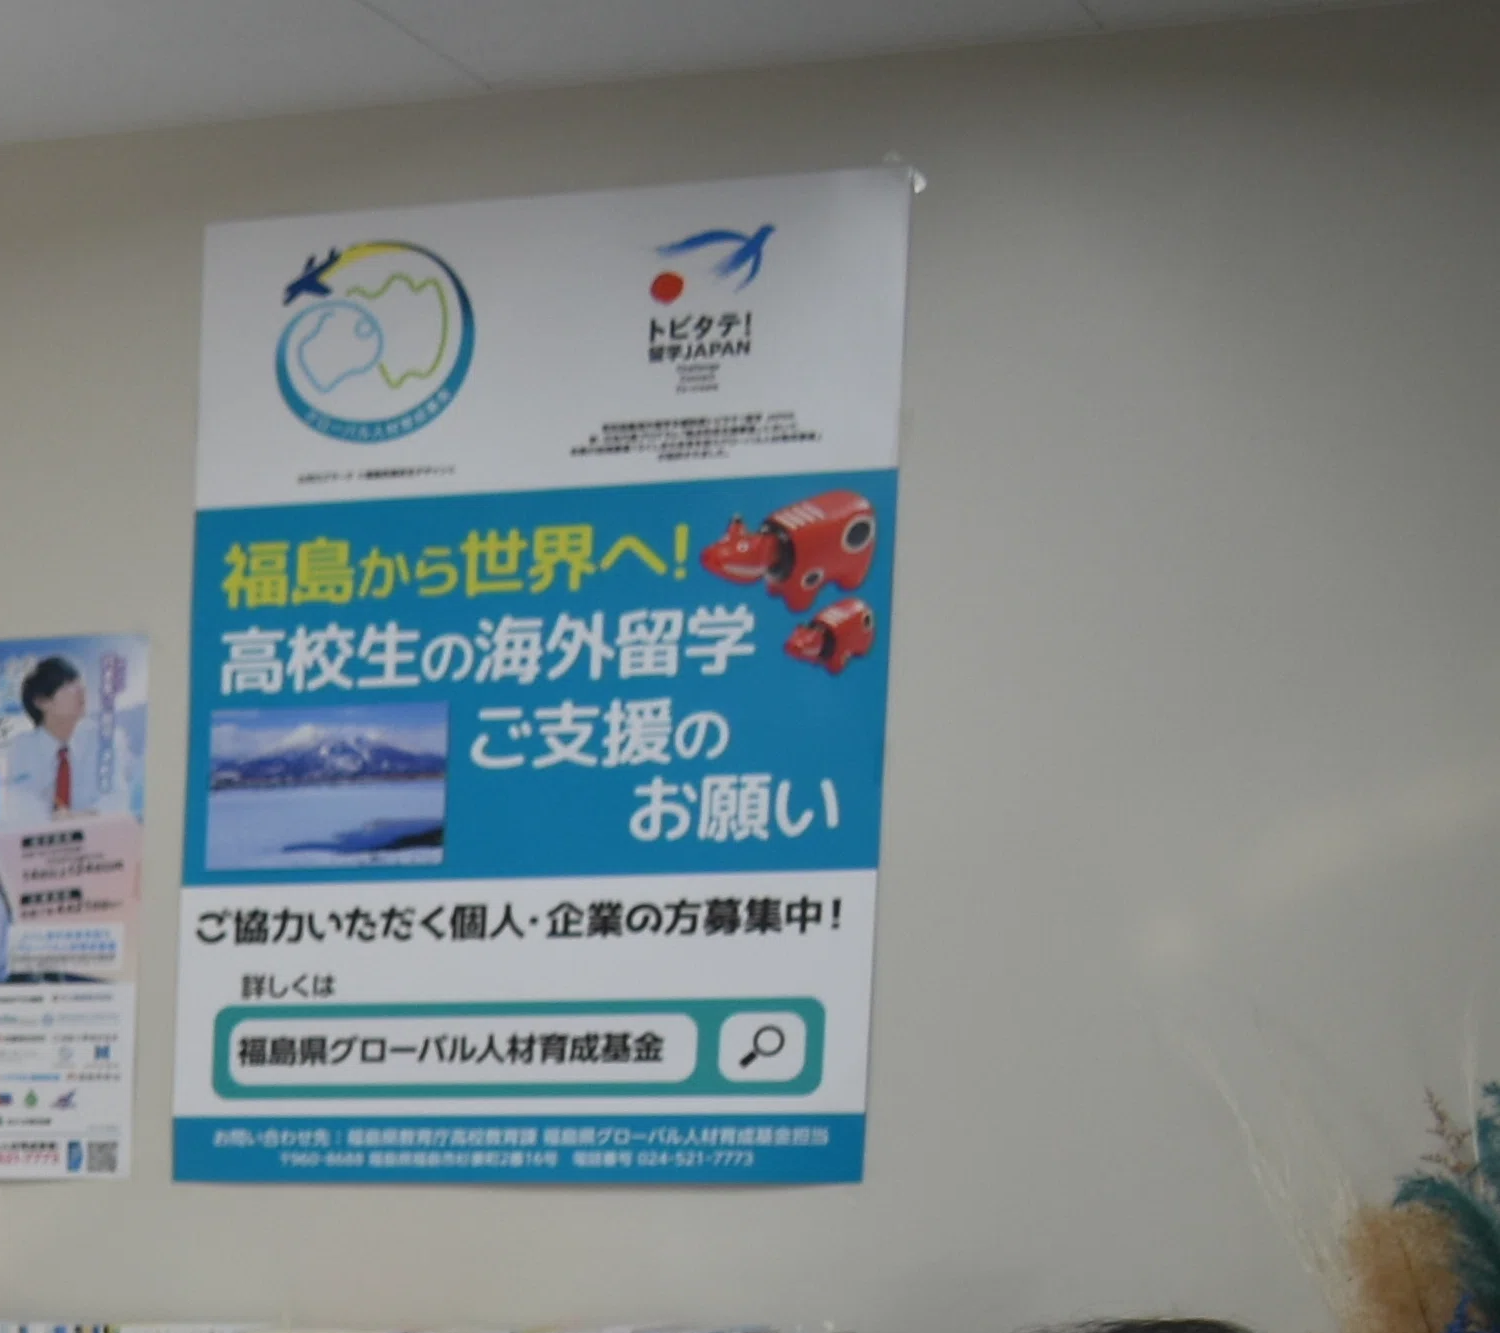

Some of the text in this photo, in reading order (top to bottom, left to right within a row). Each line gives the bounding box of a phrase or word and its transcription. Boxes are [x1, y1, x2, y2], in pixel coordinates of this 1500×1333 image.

[649, 311, 752, 342] トビタテ!
[221, 524, 689, 608] 福島から世界へ!
[219, 603, 756, 696] 高校生の海外留学
[469, 698, 730, 769] ご支援の
[629, 773, 839, 842] お願い
[196, 896, 843, 946] ご協力いただく個人・企業の方募集中!
[241, 973, 336, 999] 詳しくは
[236, 1030, 665, 1068] 福島県グローバル人材育成基金
